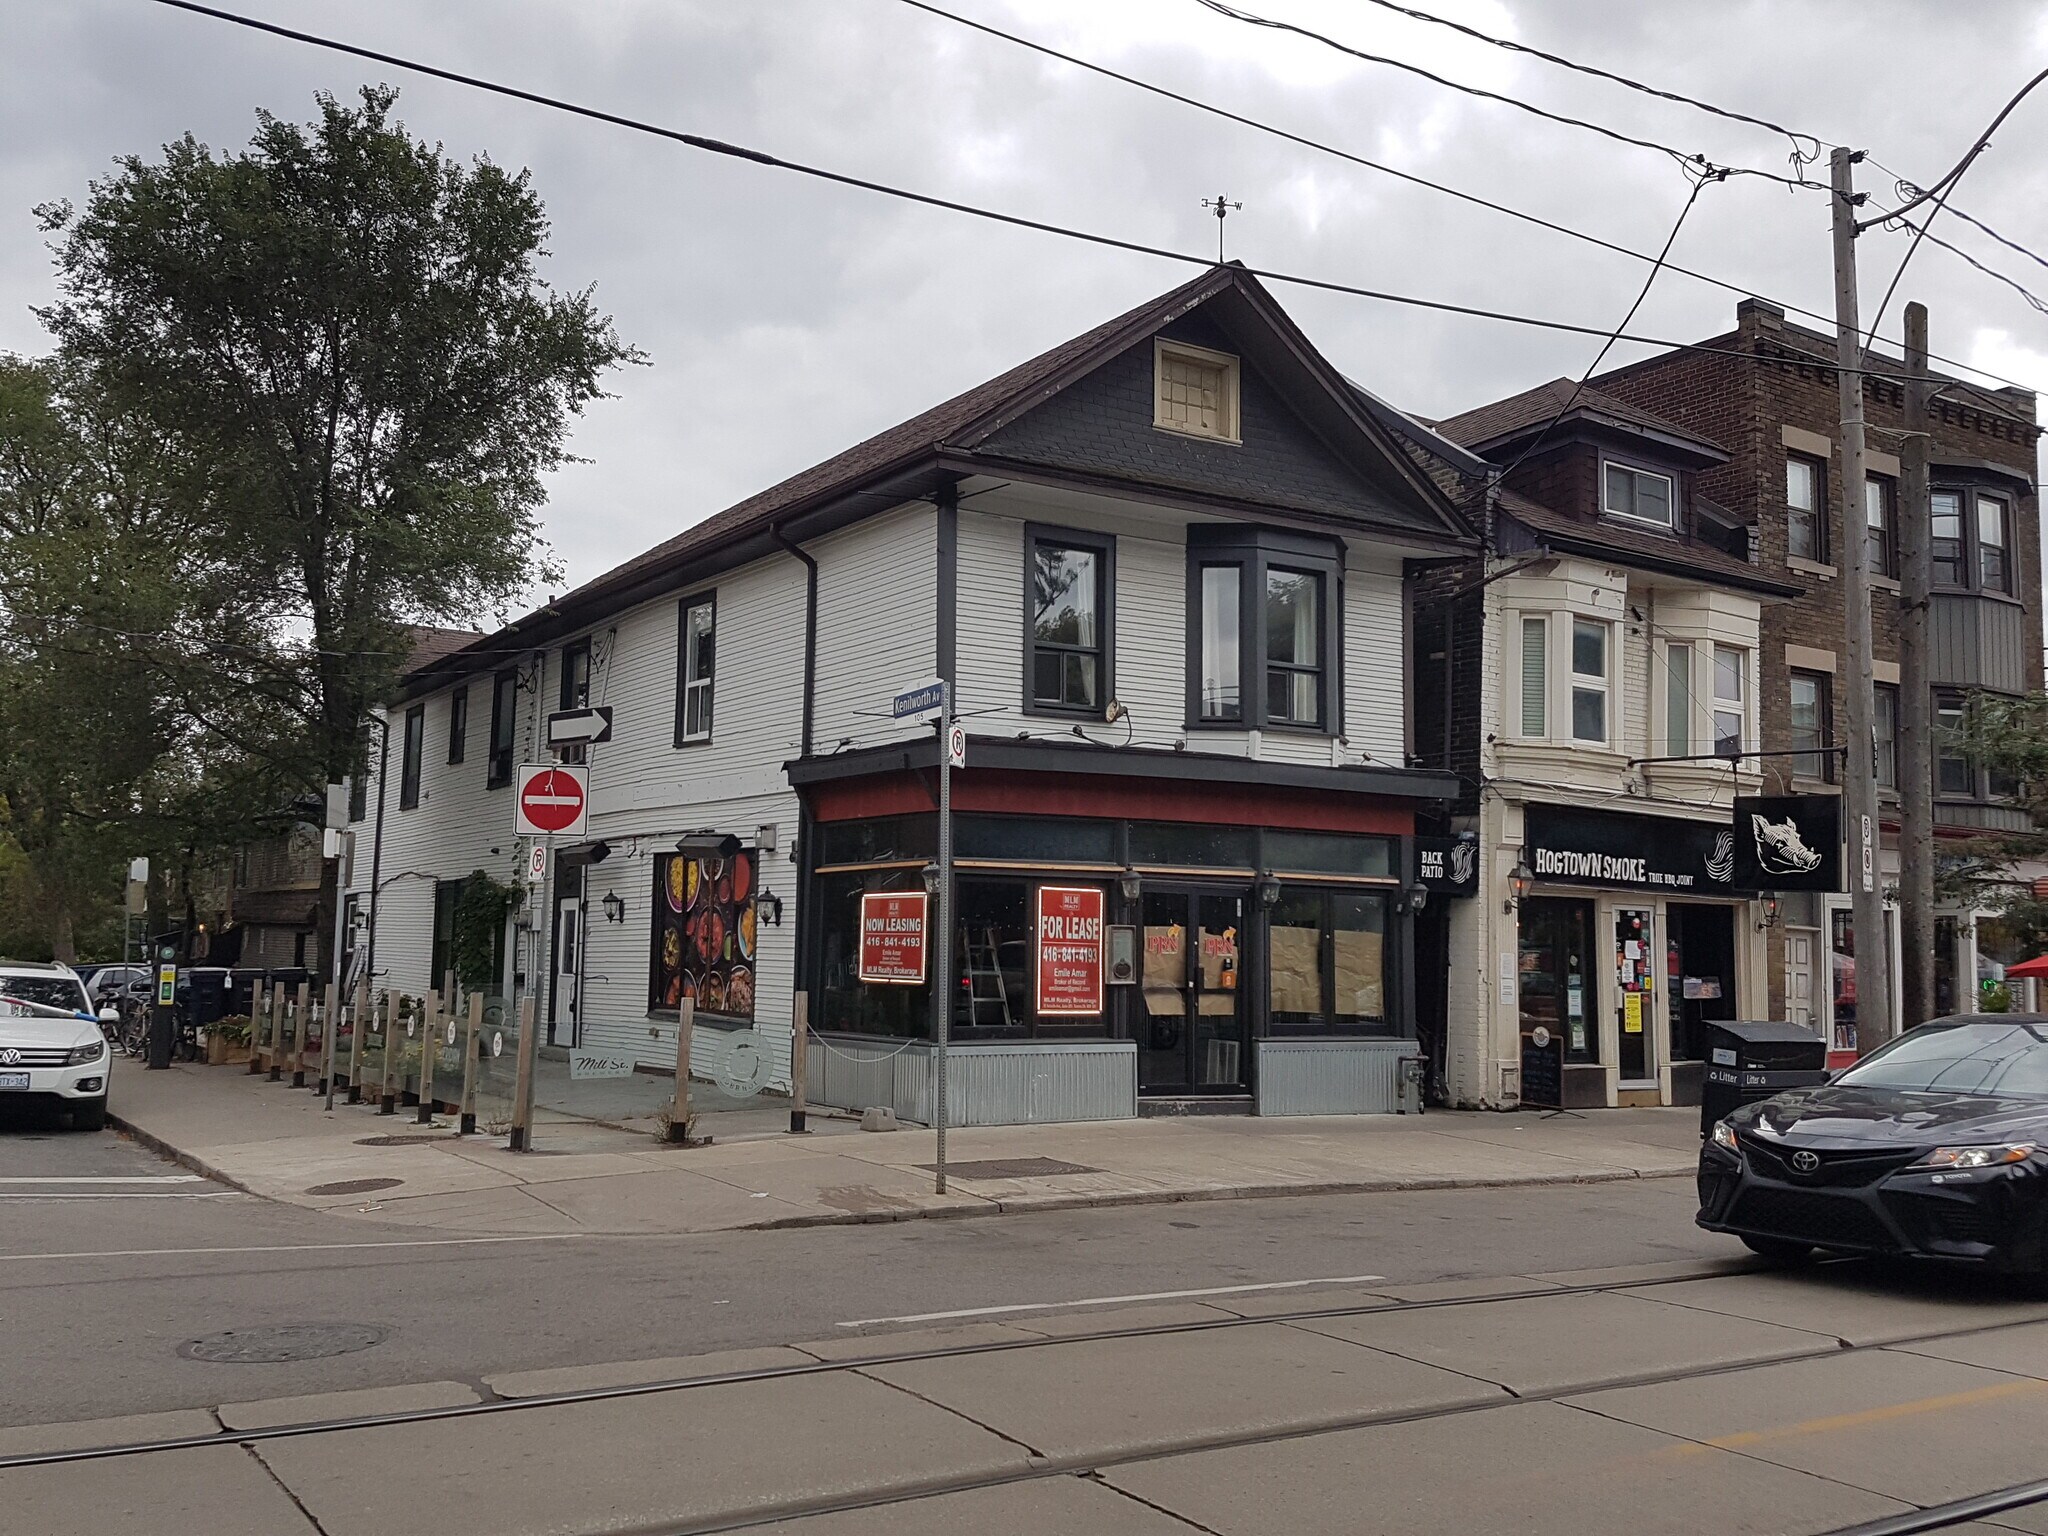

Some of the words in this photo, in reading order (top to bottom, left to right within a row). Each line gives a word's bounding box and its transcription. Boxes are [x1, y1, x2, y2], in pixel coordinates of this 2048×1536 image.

[895, 690, 931, 713] Kenilworth
[932, 691, 940, 702] Av
[914, 713, 924, 722] 105
[1421, 851, 1443, 864] BACK
[1421, 865, 1443, 878] PATIO
[1535, 848, 1602, 877] HOGTOWN
[1603, 855, 1646, 882] SMOKE
[1649, 872, 1663, 883] TRUE
[1664, 874, 1677, 887] BBQ
[1676, 875, 1694, 886] JOINT
[866, 918, 885, 931] NOW
[886, 918, 921, 932] LEASING
[1042, 916, 1063, 939] FOR
[1066, 917, 1099, 940] LEASE
[1054, 968, 1070, 977] Emile
[1071, 968, 1087, 977] Amar
[575, 1057, 609, 1070] Mill
[1720, 1071, 1738, 1083] Litter
[1747, 1075, 1760, 1084] Litter
